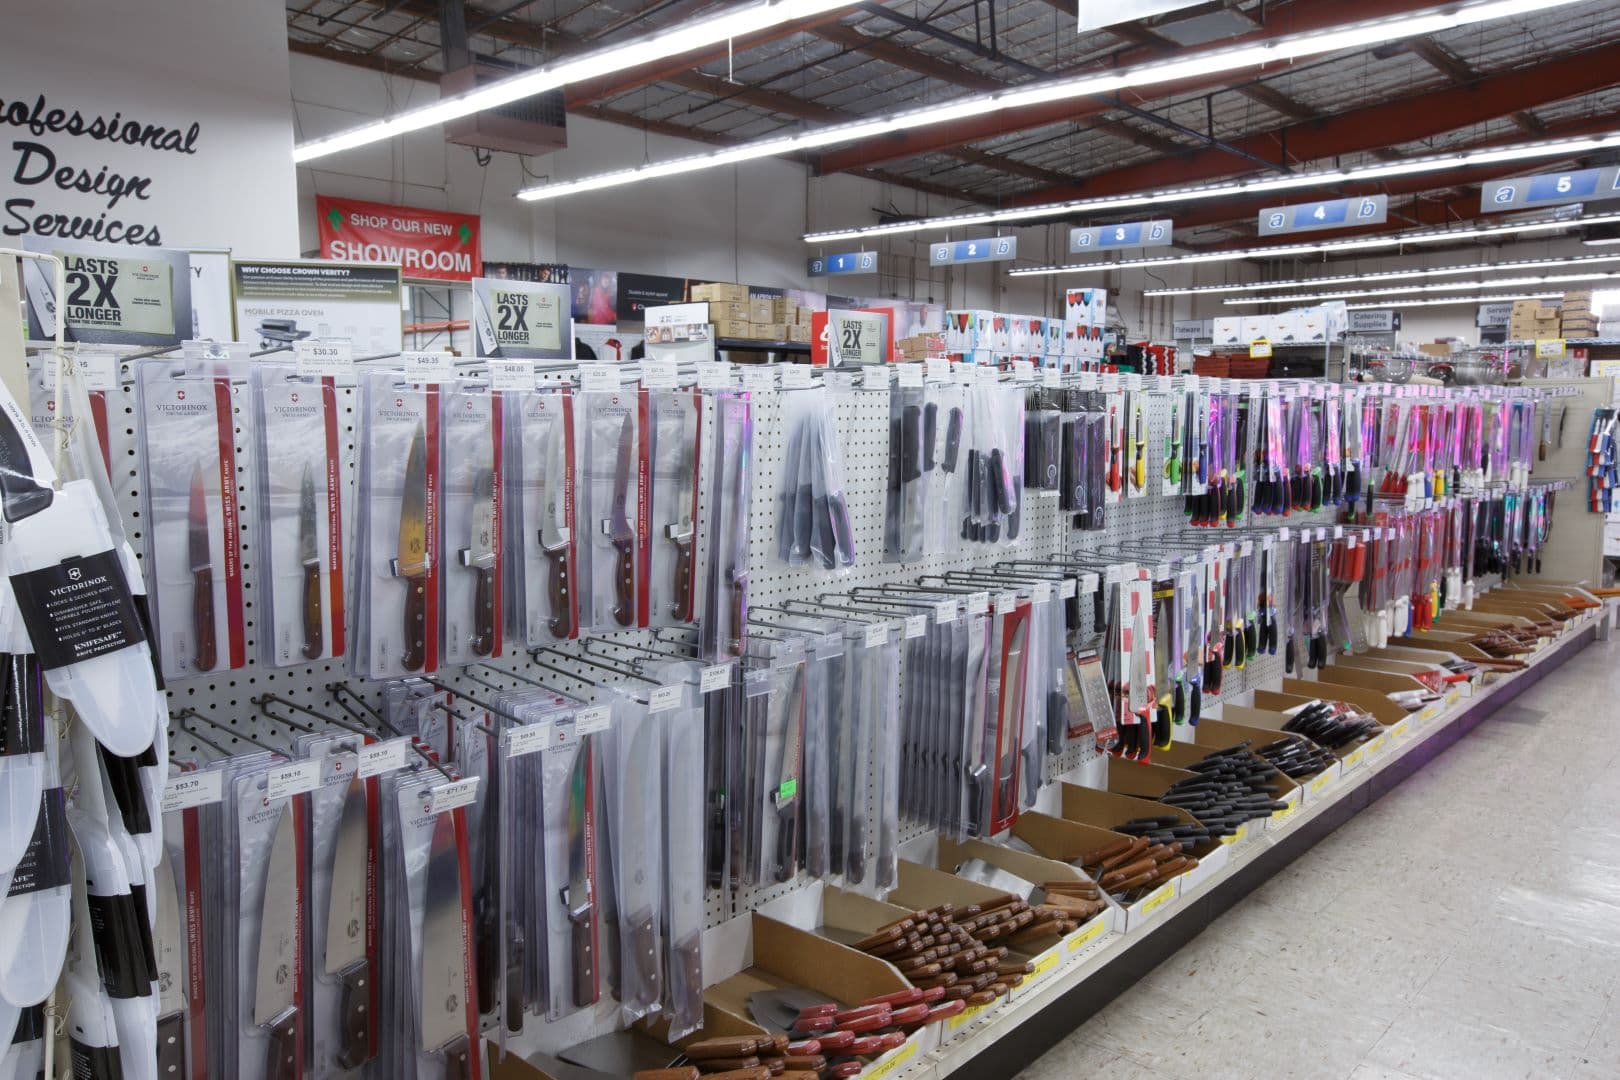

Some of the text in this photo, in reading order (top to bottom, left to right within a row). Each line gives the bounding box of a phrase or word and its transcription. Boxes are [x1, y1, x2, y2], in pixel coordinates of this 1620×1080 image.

[12, 141, 152, 209] Design
[1495, 176, 1571, 203] a 5
[2, 198, 162, 246] Services
[1269, 199, 1376, 229] a 4 b
[350, 213, 453, 236] SHOP OUR NEW
[1078, 224, 1164, 246] a 3 b
[330, 239, 471, 272] SHOWROOM
[937, 240, 1009, 260] a 2 b
[64, 256, 119, 275] LASTS
[241, 266, 260, 274] WHY
[812, 255, 871, 272] a 1 b
[65, 272, 120, 308] 2X
[497, 292, 529, 305] LASTS
[67, 306, 121, 321] LONGER
[277, 308, 300, 316] PIZZA
[497, 304, 529, 331] 2X
[1353, 312, 1387, 321] Catering
[1486, 306, 1512, 314] Servin
[843, 320, 862, 330] LASTS
[1353, 320, 1387, 329] Supplies
[497, 330, 529, 341] LONGER
[842, 329, 862, 349] 2X
[313, 348, 338, 356] $30.30
[842, 349, 862, 357] LONGER
[156, 404, 208, 412] VICTORINOX
[50, 576, 107, 596] VICTORINOX
[94, 639, 126, 652] PROTECTION
[175, 780, 199, 791] $53.70
